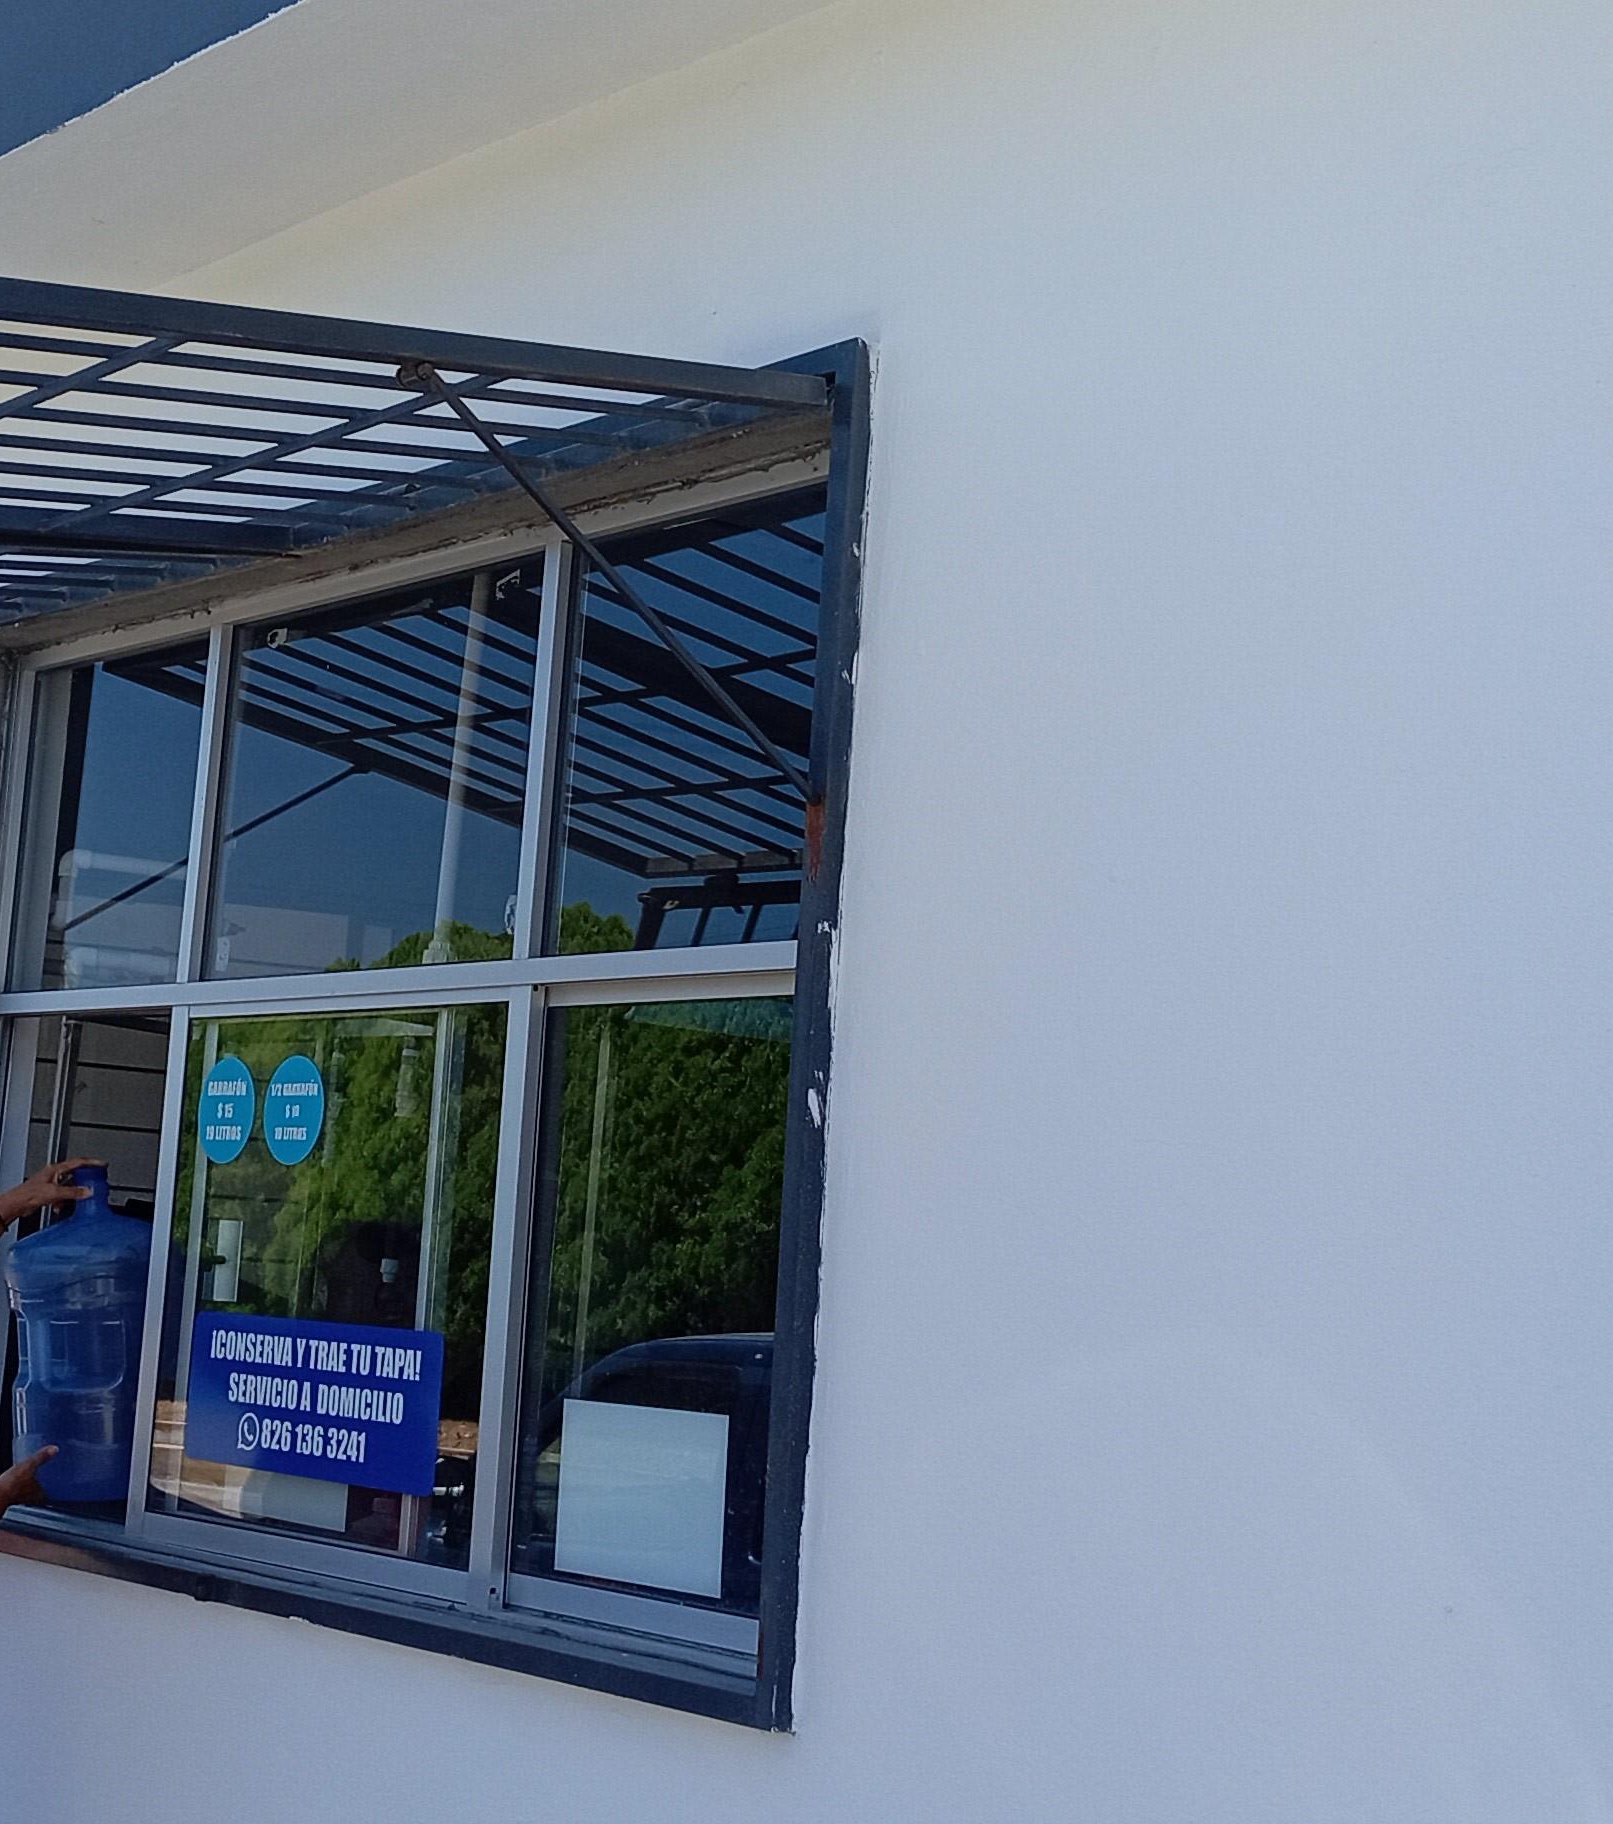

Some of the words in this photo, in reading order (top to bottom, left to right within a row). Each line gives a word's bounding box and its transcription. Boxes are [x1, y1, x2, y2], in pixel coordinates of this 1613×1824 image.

[215, 1125, 242, 1141] LITROS
[210, 1329, 293, 1368] ¡CONSERVA
[296, 1337, 308, 1368] Y
[308, 1338, 348, 1373] TRAE
[350, 1345, 374, 1375] TU
[375, 1347, 422, 1381] TAPA!
[228, 1372, 298, 1410] SERVICIO
[299, 1381, 311, 1411] A
[317, 1384, 404, 1425] DOMICILIO
[261, 1419, 292, 1452] 826
[295, 1424, 324, 1456] 136
[326, 1429, 366, 1464] 3241
